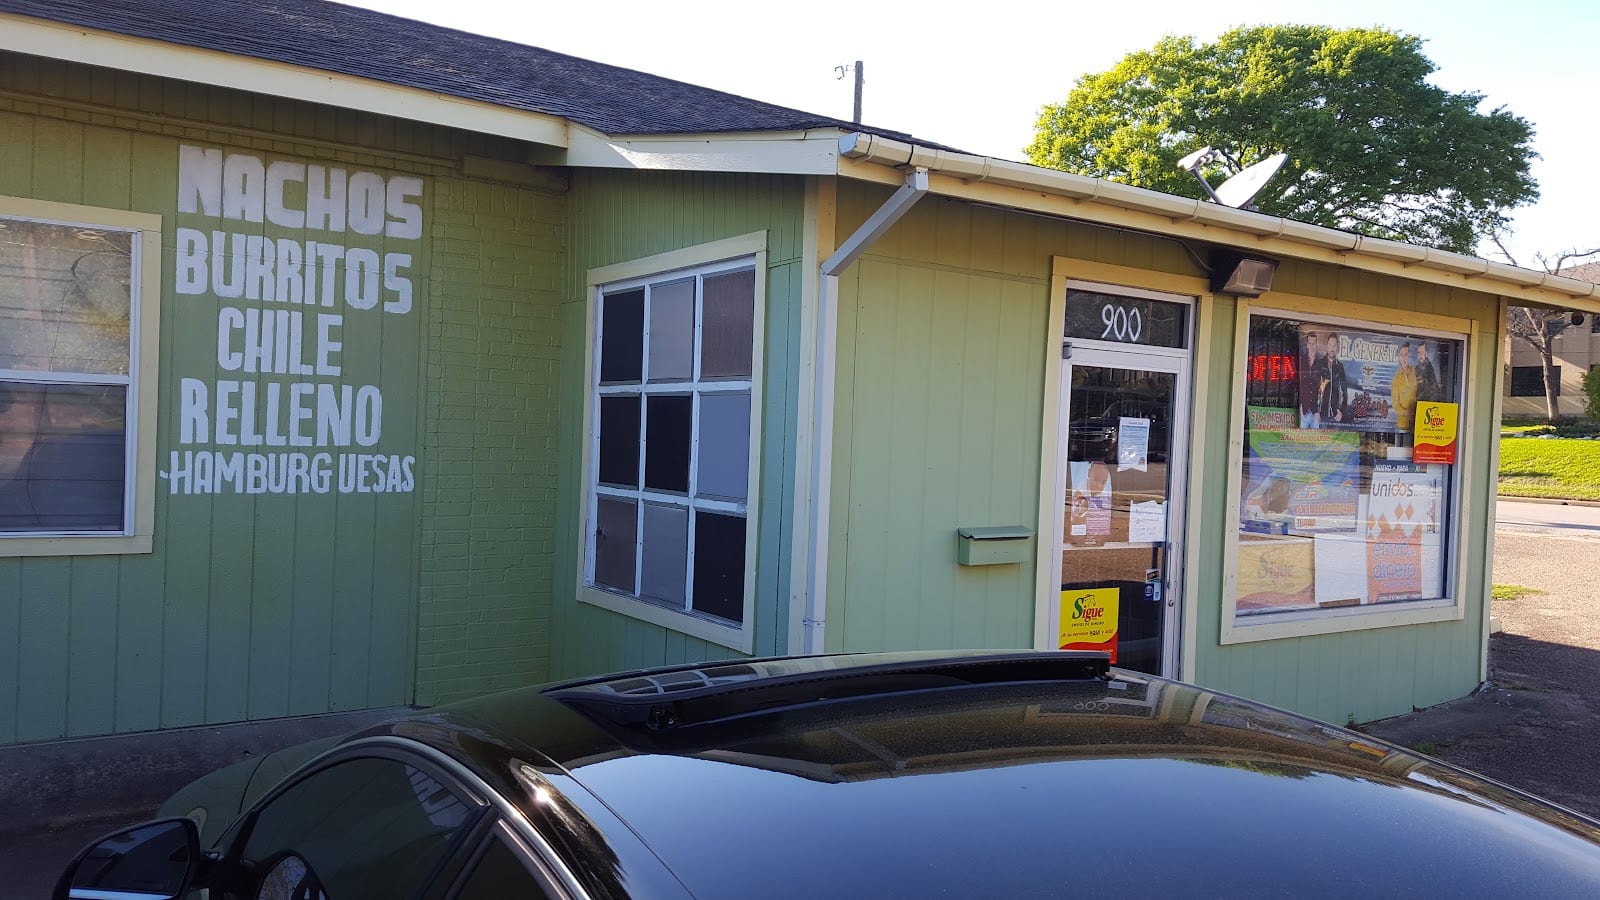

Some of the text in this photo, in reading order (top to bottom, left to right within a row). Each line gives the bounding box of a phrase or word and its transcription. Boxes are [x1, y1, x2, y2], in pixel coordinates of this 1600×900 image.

[178, 145, 424, 240] NACHOS
[175, 228, 413, 315] BURRITOS
[217, 307, 344, 376] CHILE
[1101, 303, 1141, 342] 900
[180, 378, 383, 447] RELLENO
[1423, 407, 1446, 428] Sigue
[1373, 560, 1417, 579] dinero
[1072, 597, 1104, 622] Sigue
